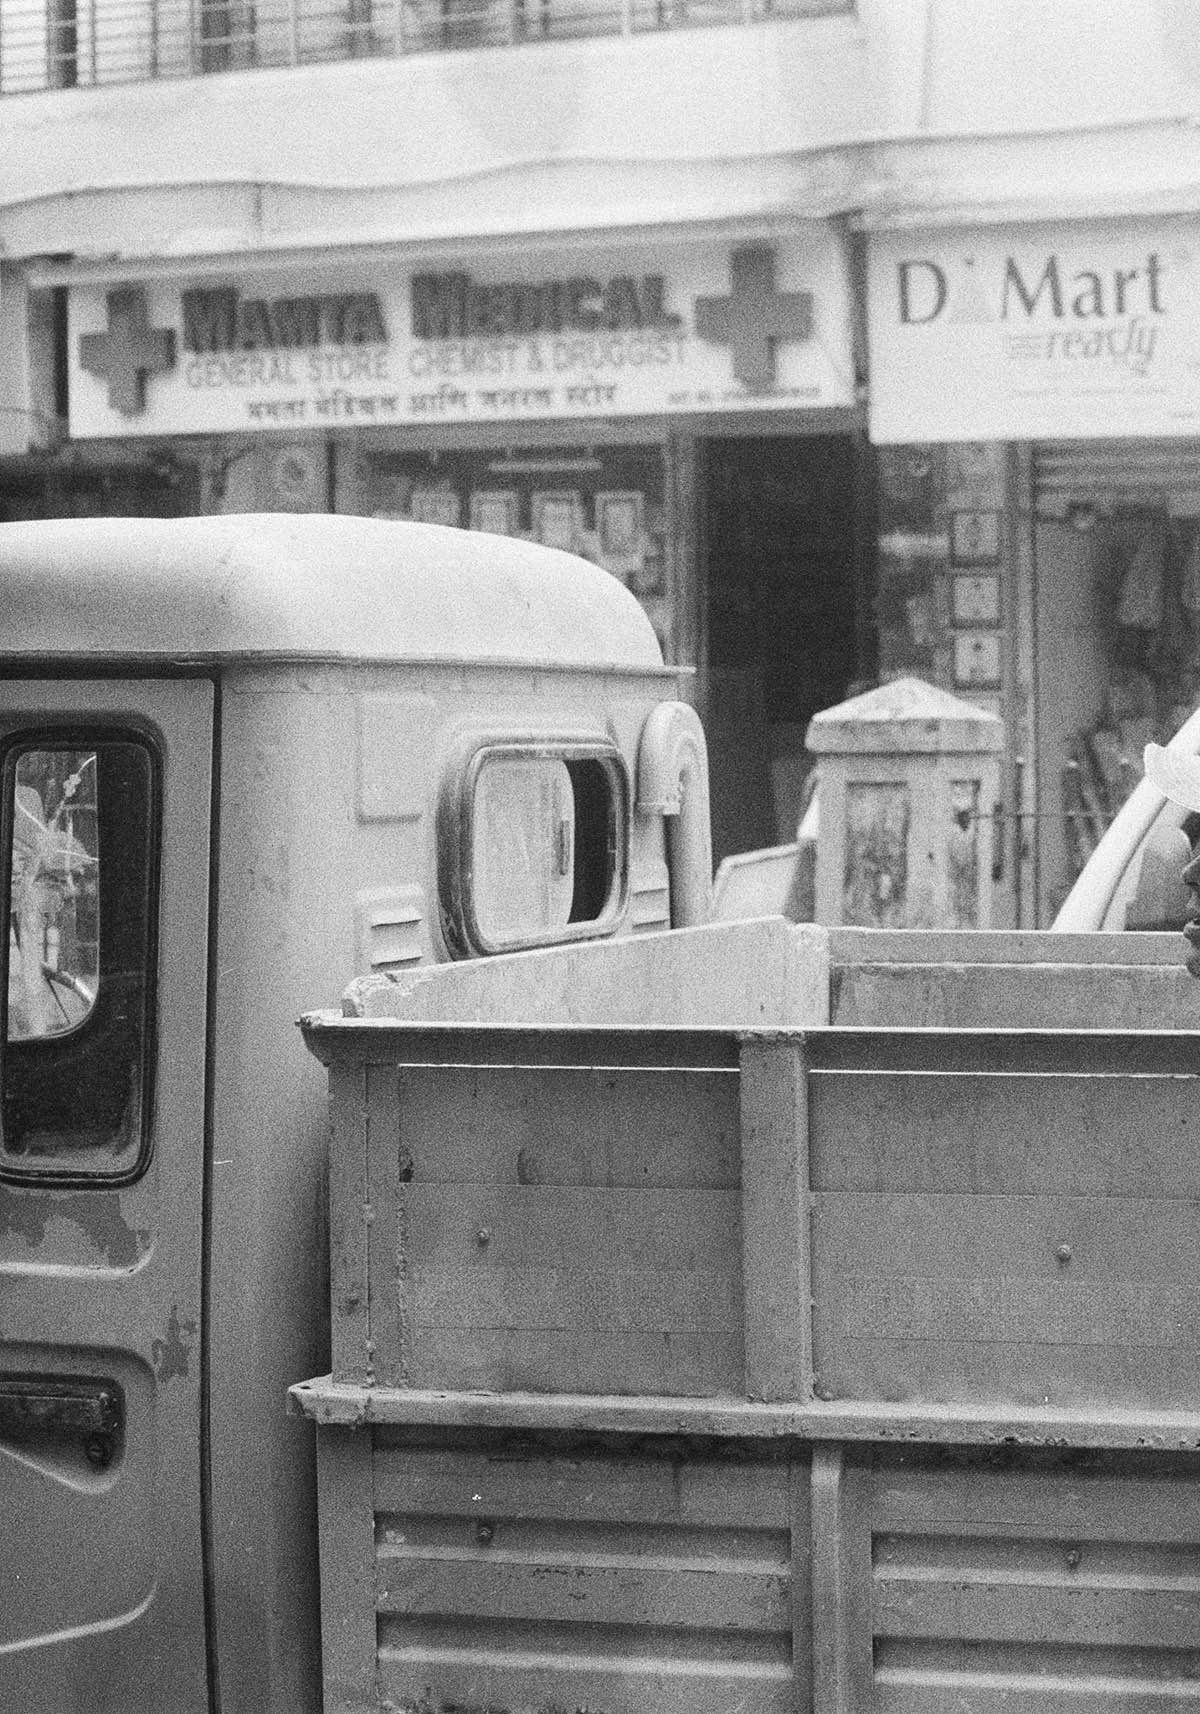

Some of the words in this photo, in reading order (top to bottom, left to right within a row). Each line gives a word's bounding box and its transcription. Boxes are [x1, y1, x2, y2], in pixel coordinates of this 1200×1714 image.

[999, 252, 1166, 319] Mart
[186, 349, 298, 390] GENERAL
[308, 343, 390, 383] STORE
[408, 340, 519, 378] CHEMIST
[527, 340, 544, 373] &
[553, 331, 687, 372] DRUGGIST
